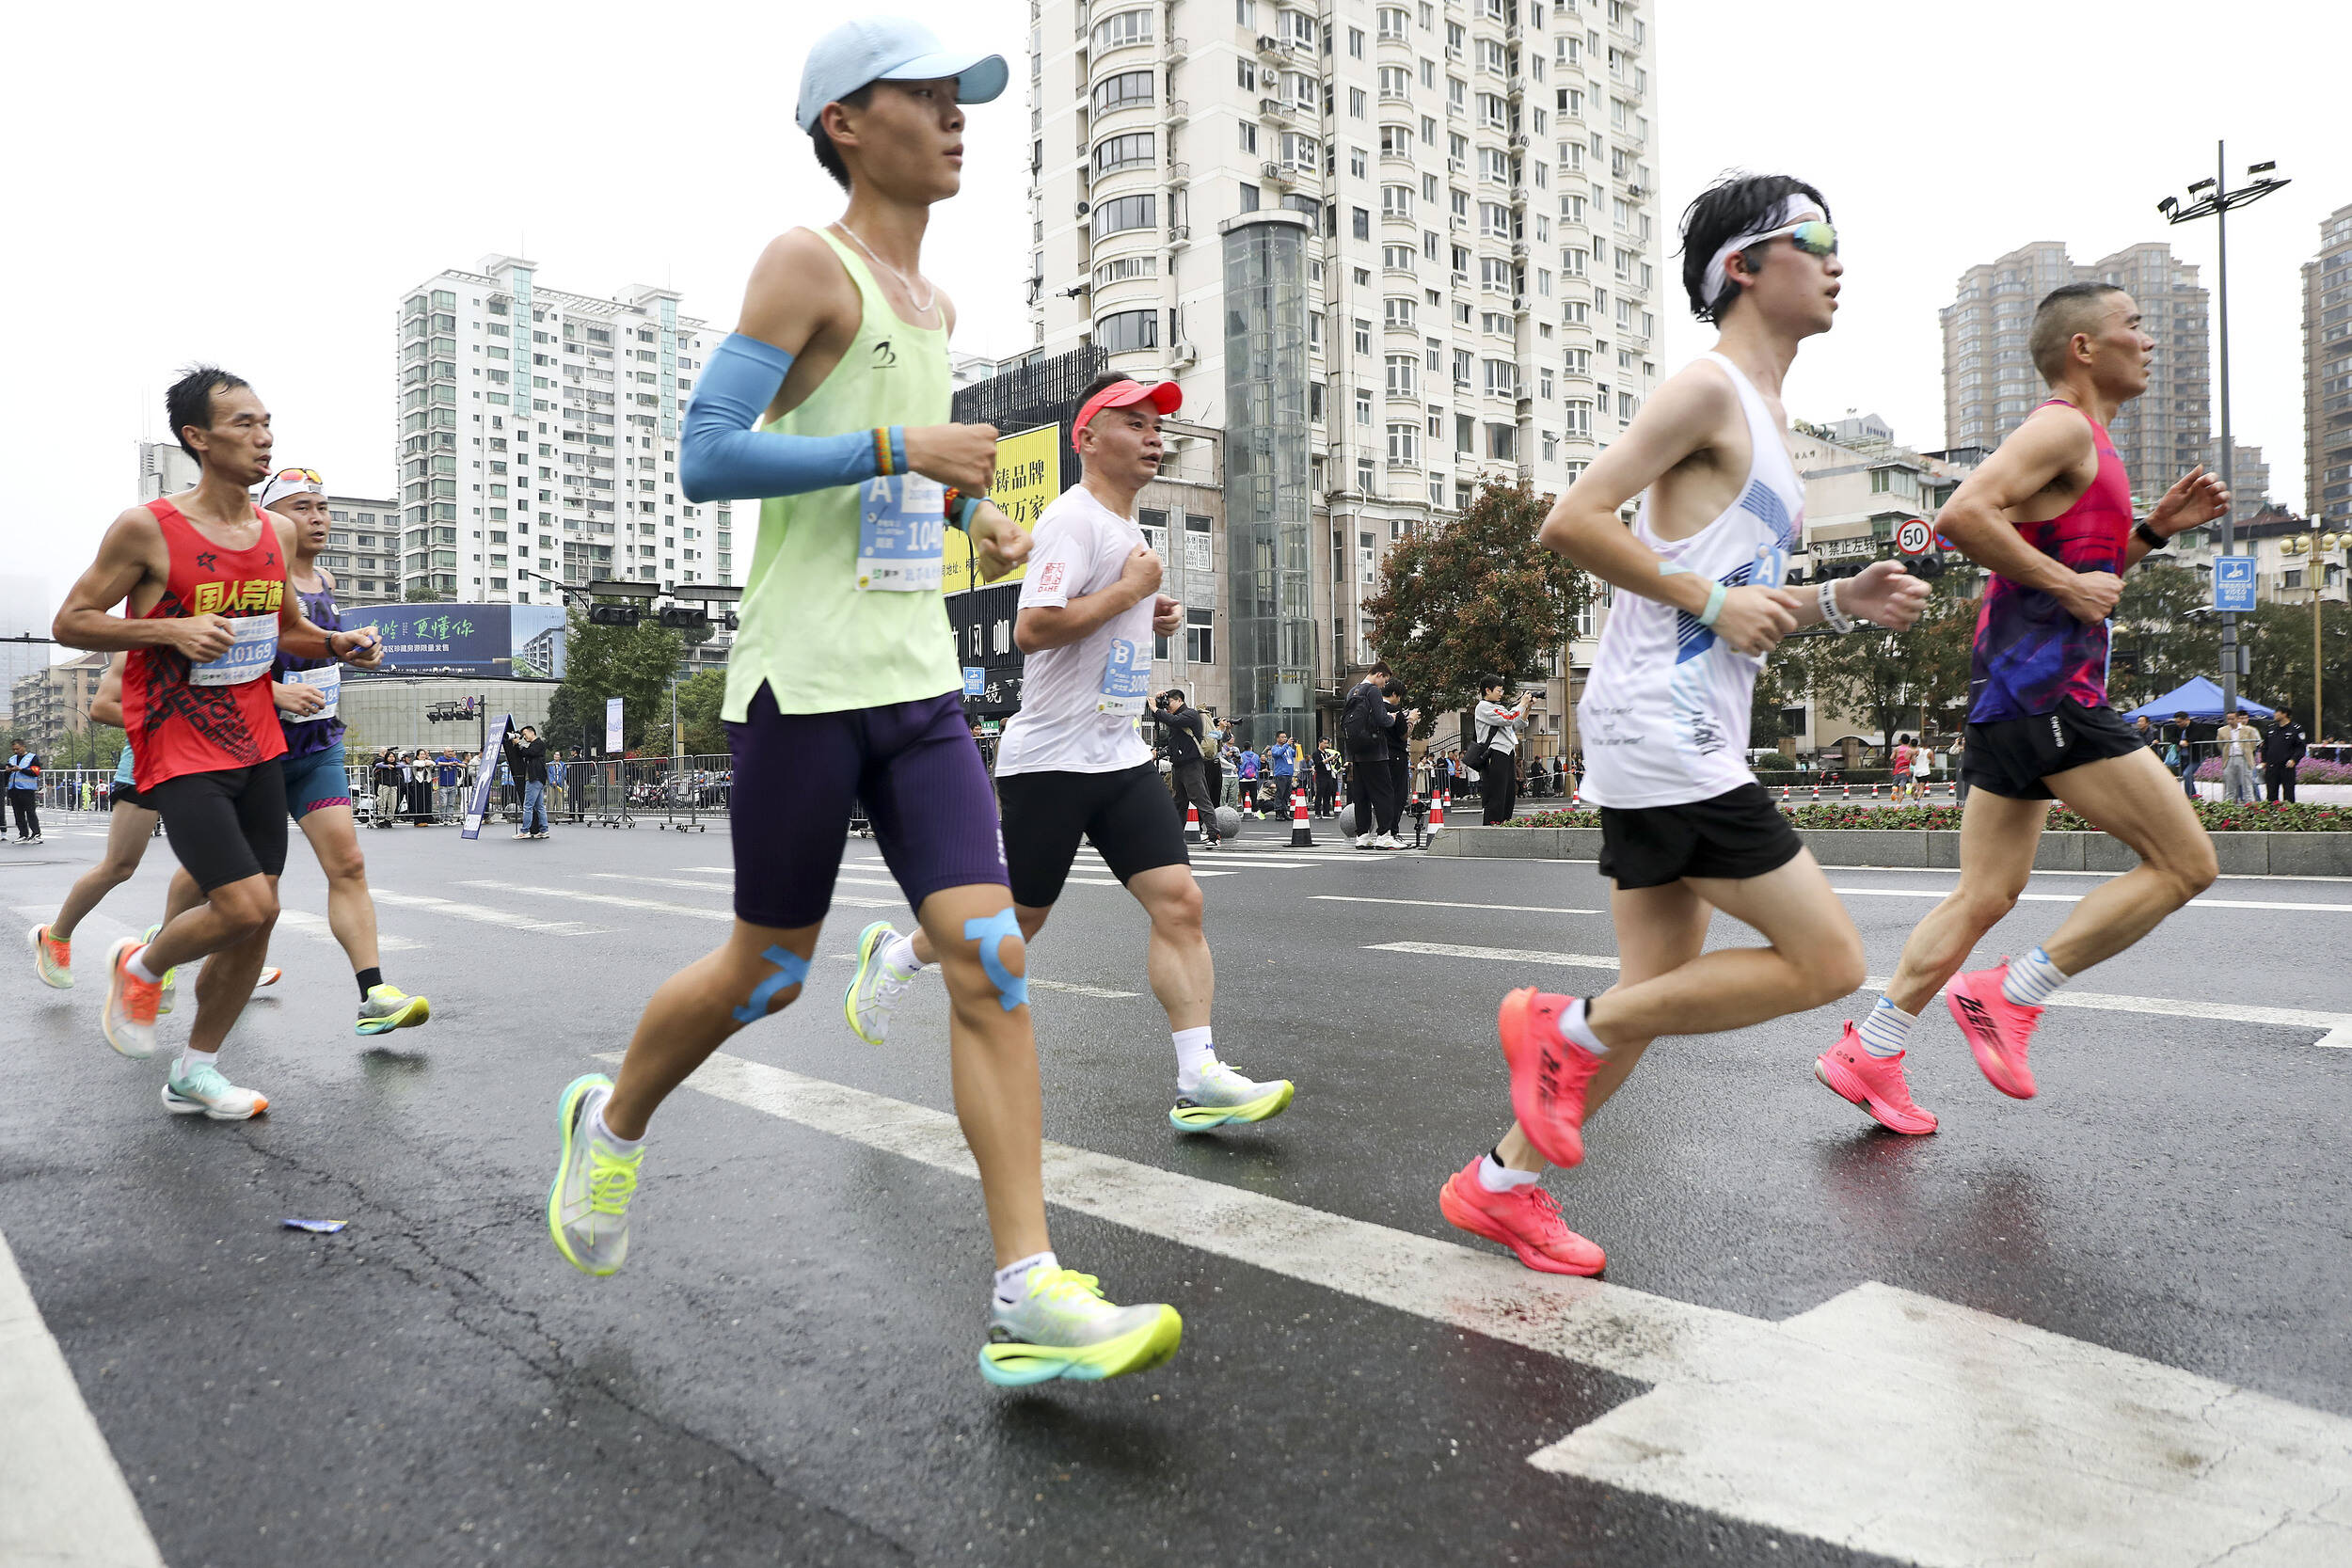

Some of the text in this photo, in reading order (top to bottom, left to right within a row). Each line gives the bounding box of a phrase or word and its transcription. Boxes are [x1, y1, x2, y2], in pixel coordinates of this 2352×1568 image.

[868, 476, 893, 503] A
[985, 460, 1044, 496] 铸品牌
[1828, 536, 1877, 556] 禁止左转
[1903, 528, 1924, 546] 50
[1756, 555, 1774, 583] A
[413, 615, 475, 641] 更懂你
[226, 642, 273, 664] 10169
[1114, 645, 1130, 664] B
